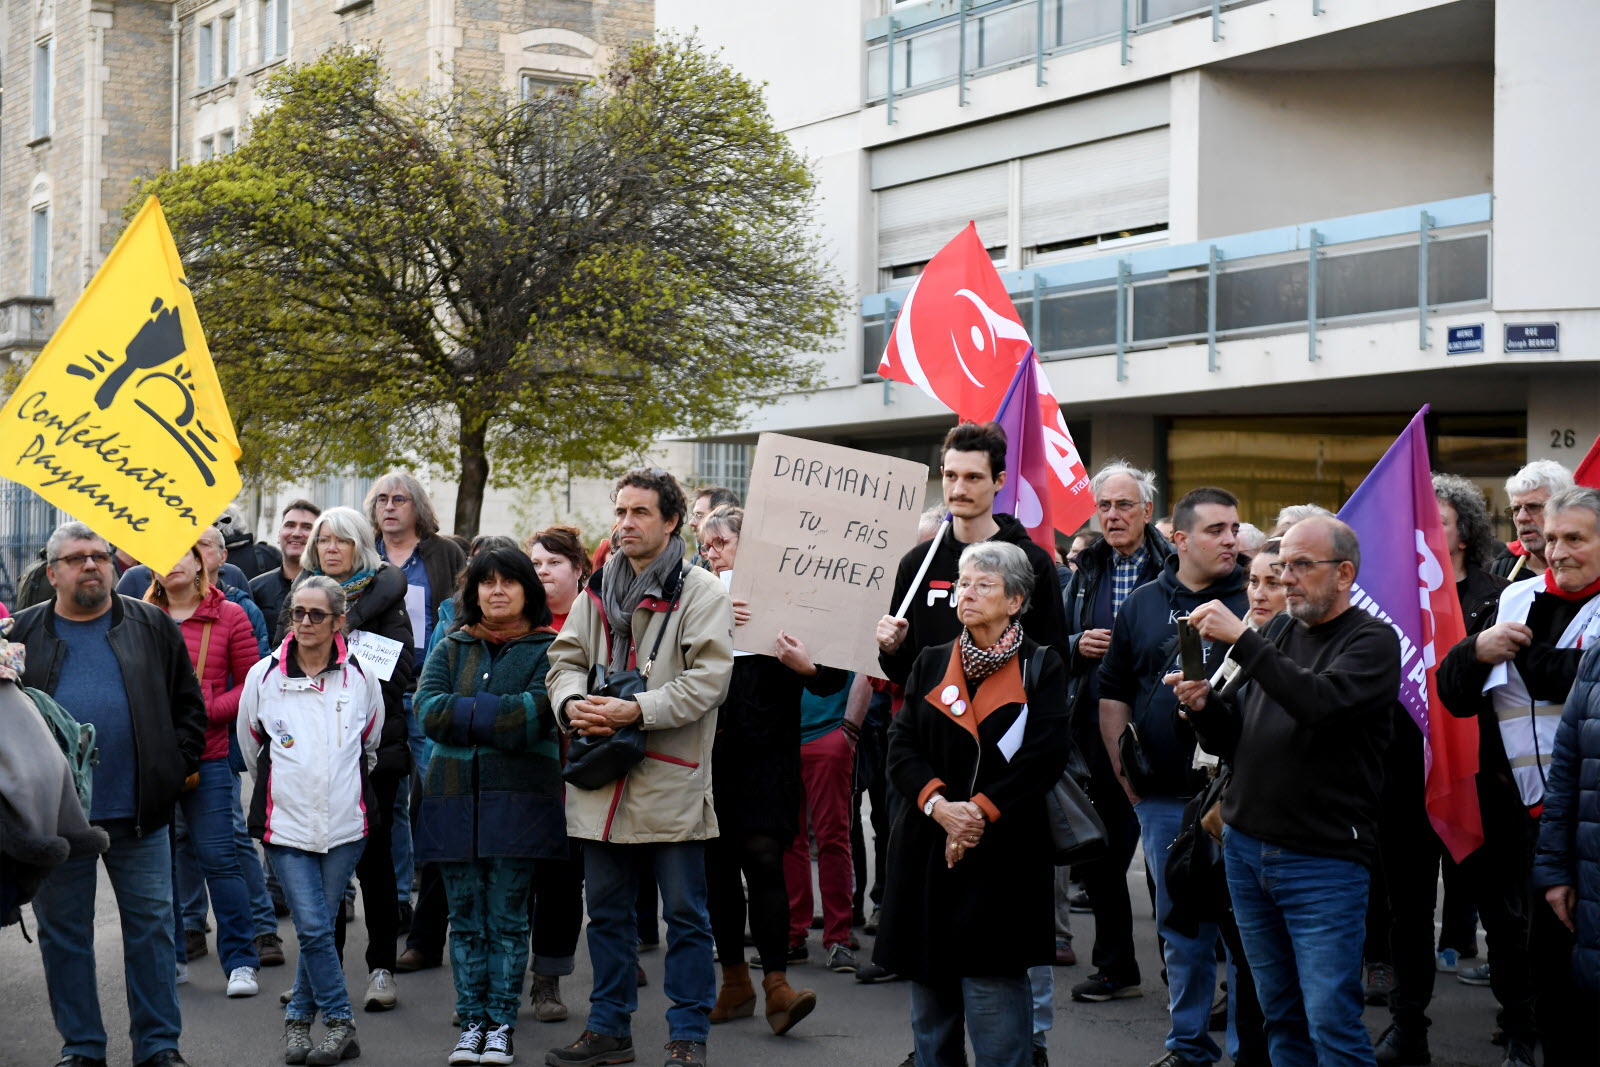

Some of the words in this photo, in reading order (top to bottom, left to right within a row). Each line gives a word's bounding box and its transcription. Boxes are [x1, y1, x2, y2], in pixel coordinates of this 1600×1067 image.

[1524, 327, 1539, 337] RUE
[1507, 339, 1527, 349] Joseph
[1528, 338, 1556, 348] BERNIER
[1550, 428, 1576, 449] 26
[18, 391, 198, 526] Confédération
[16, 433, 150, 532] Paysanne
[800, 510, 822, 531] TU
[778, 544, 885, 590] FÜHRER
